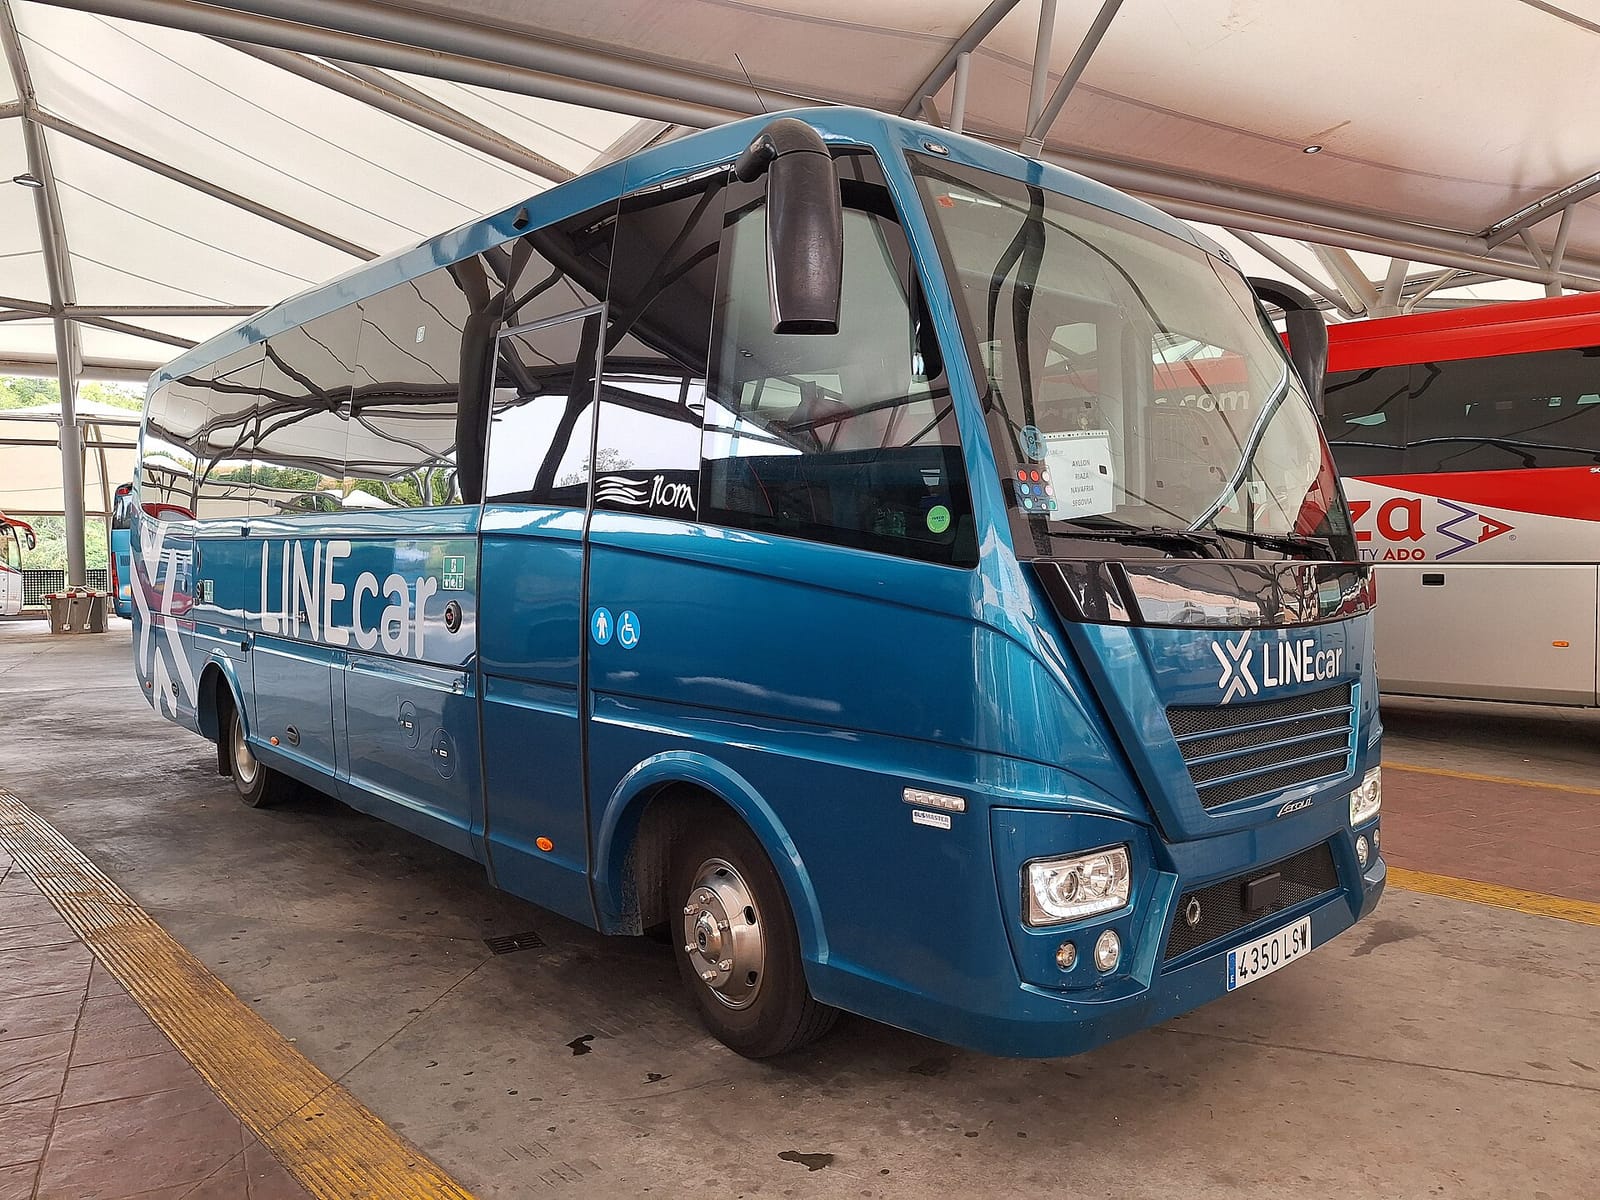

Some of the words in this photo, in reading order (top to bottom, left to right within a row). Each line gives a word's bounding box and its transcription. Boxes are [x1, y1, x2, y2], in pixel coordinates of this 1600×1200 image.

[1071, 498, 1093, 507] SEGOVIA
[1383, 548, 1426, 561] ADO
[261, 539, 438, 659] LINEcar
[1263, 639, 1343, 688] LINEcar
[1239, 938, 1280, 979] 4350
[1283, 922, 1308, 961] LSW
